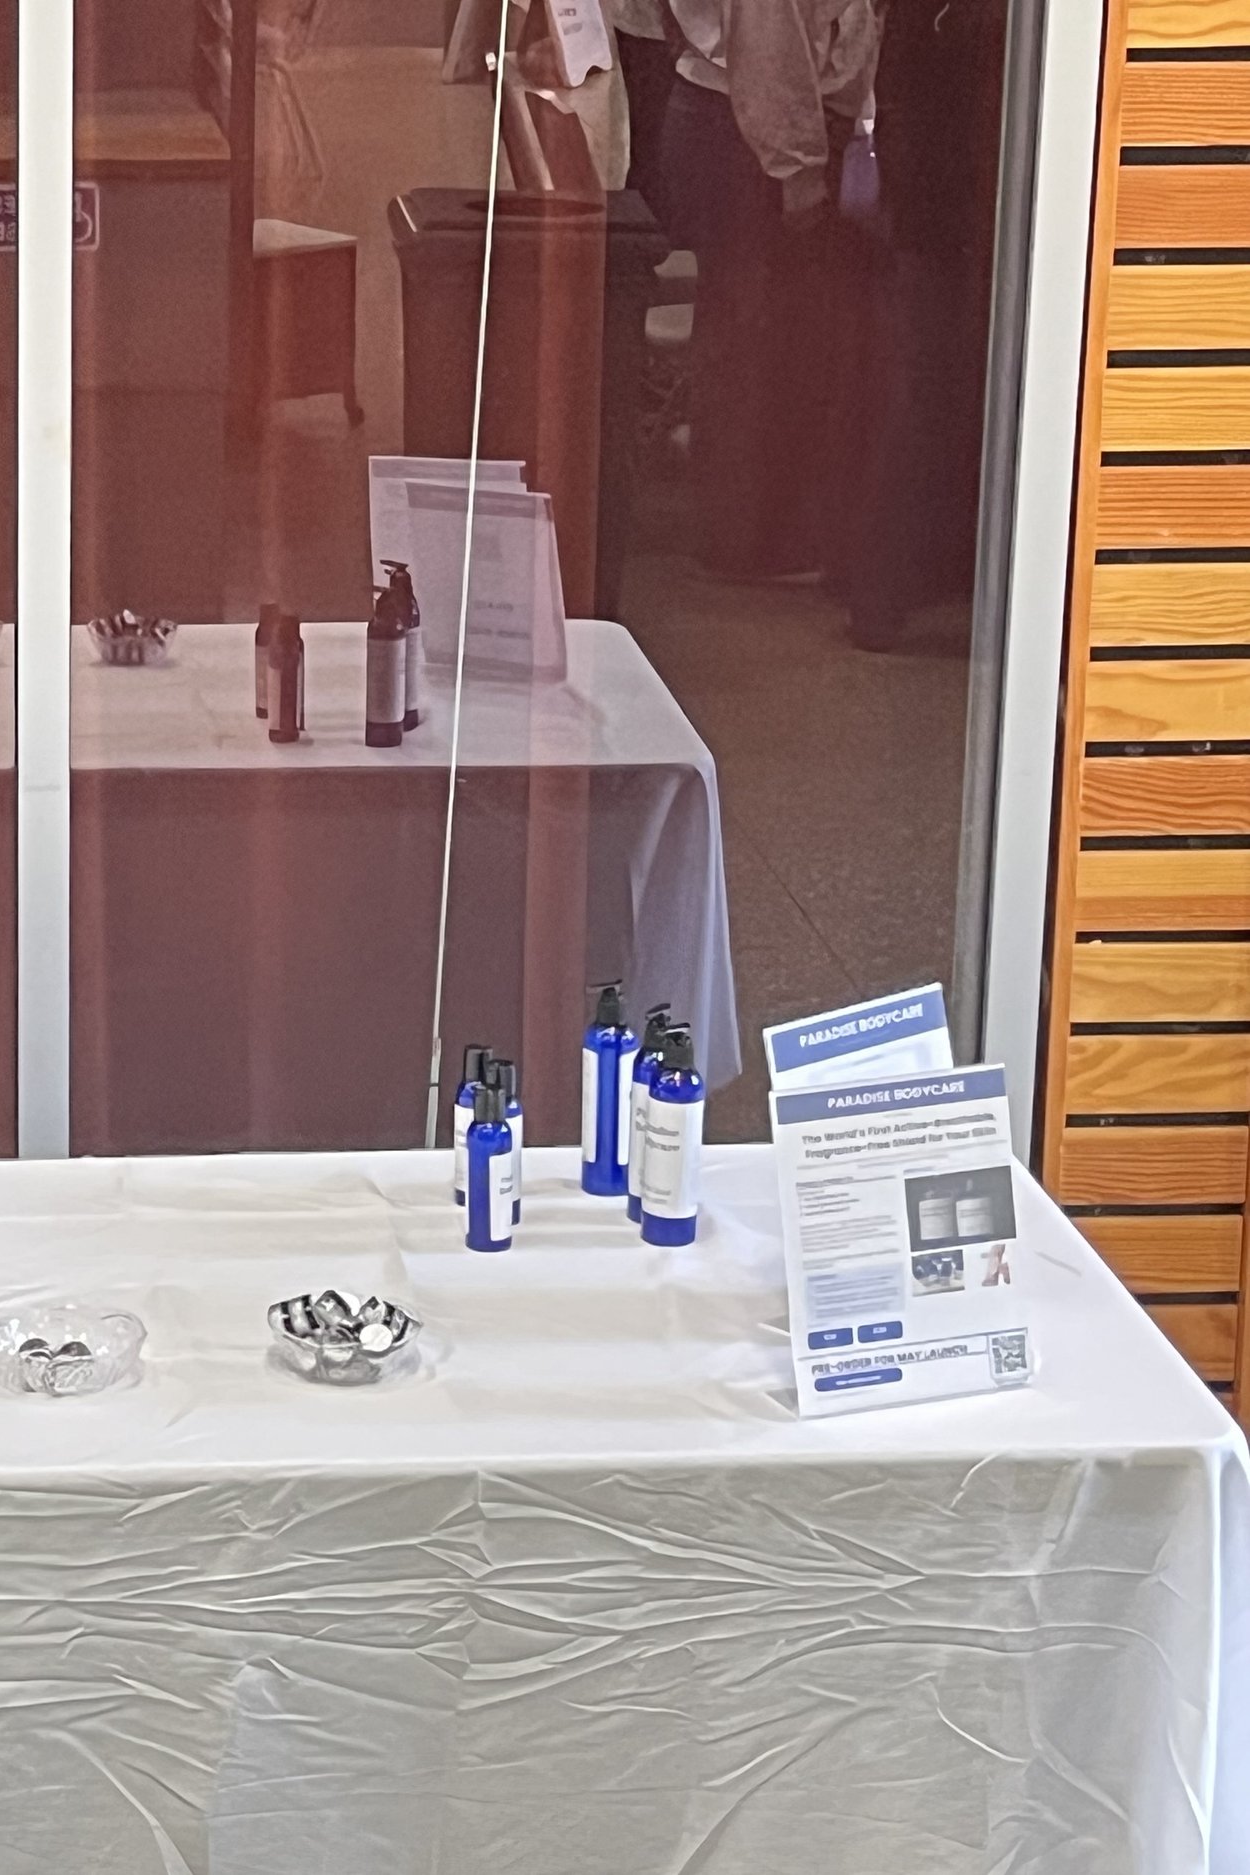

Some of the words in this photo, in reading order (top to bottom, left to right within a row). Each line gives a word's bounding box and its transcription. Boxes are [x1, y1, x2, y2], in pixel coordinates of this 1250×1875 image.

[799, 1020, 858, 1048] PARADISE
[858, 1003, 924, 1033] BODYCARE
[827, 1089, 891, 1108] PARADISE
[893, 1080, 966, 1101] BODYCARE
[897, 1350, 922, 1363] MAY
